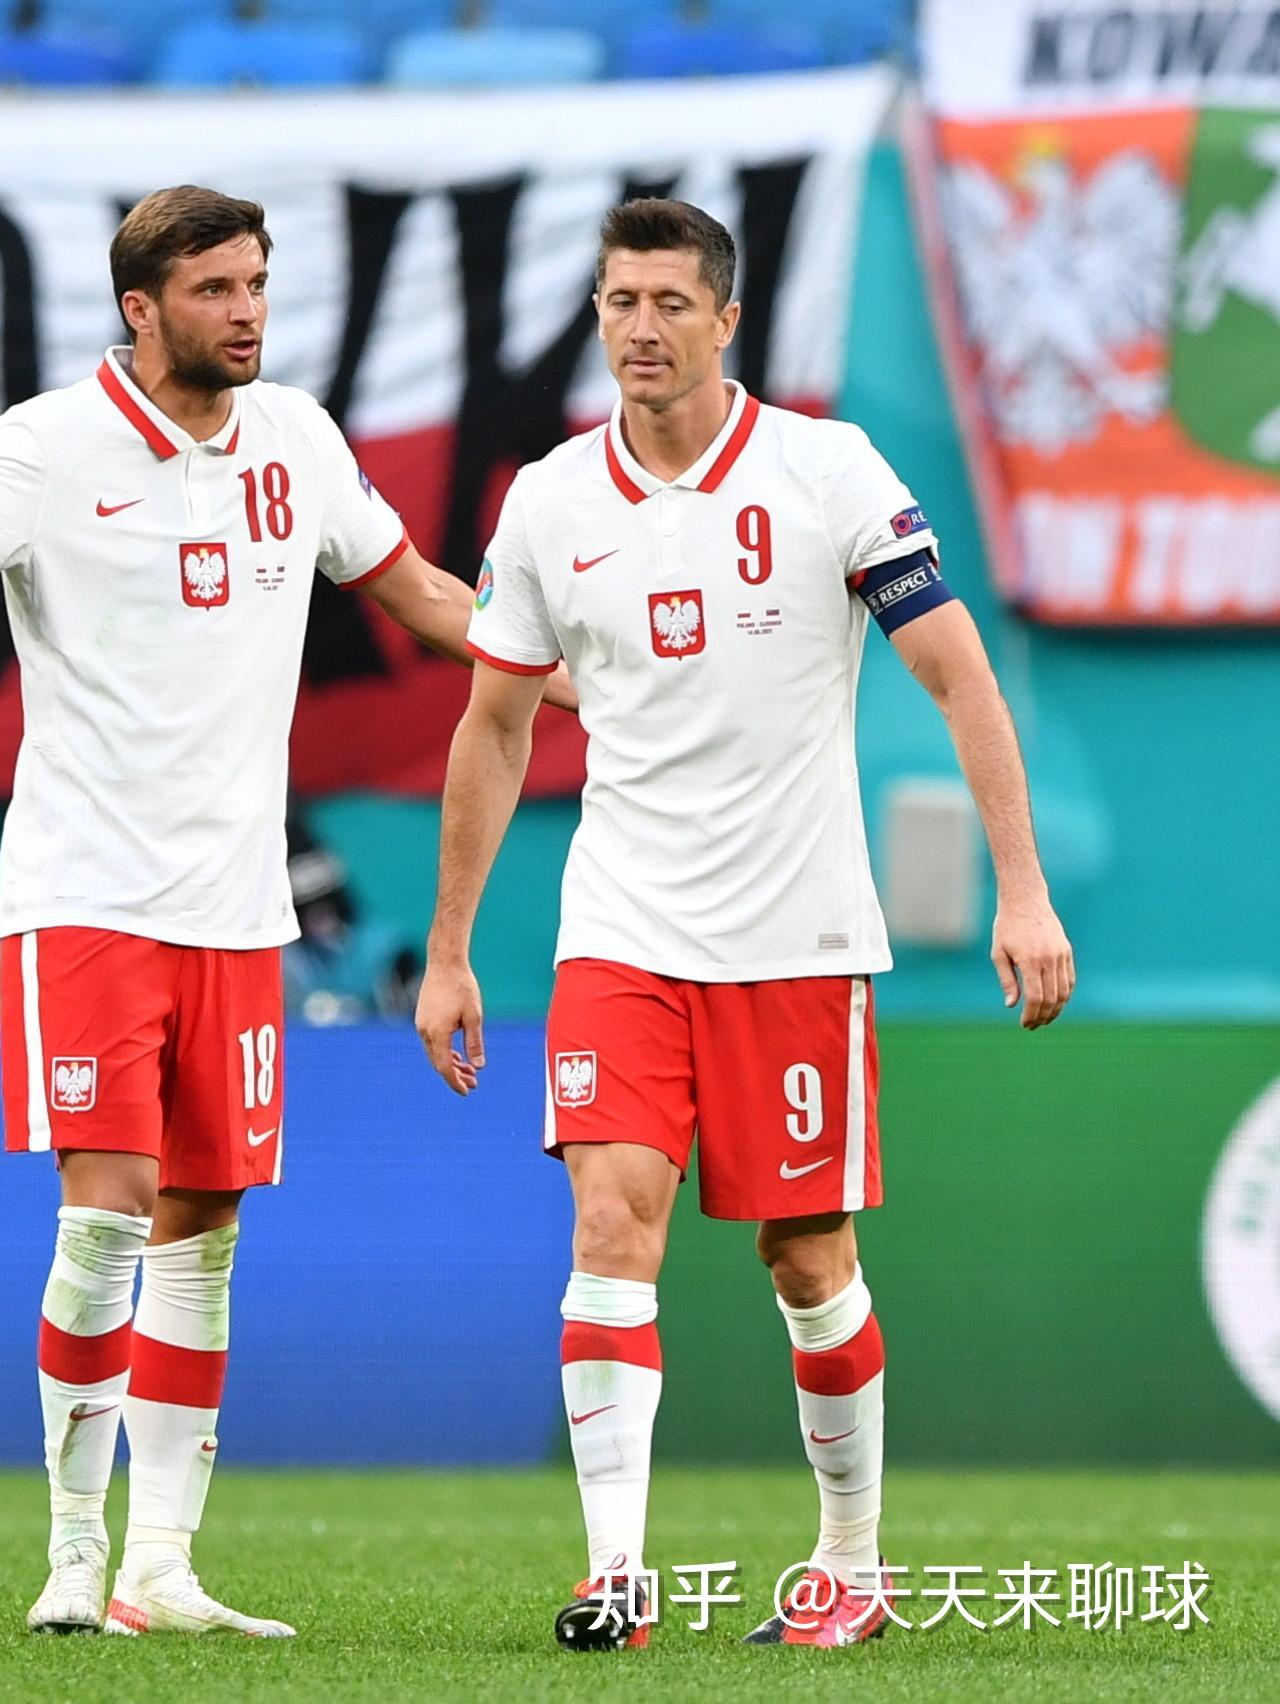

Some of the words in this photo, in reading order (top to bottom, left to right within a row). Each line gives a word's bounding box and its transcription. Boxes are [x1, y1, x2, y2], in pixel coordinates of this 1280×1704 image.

[238, 461, 295, 542] 18
[735, 504, 774, 586] 9
[878, 571, 929, 604] RESPECT
[237, 1024, 278, 1109] 18
[782, 1063, 824, 1142] 9
